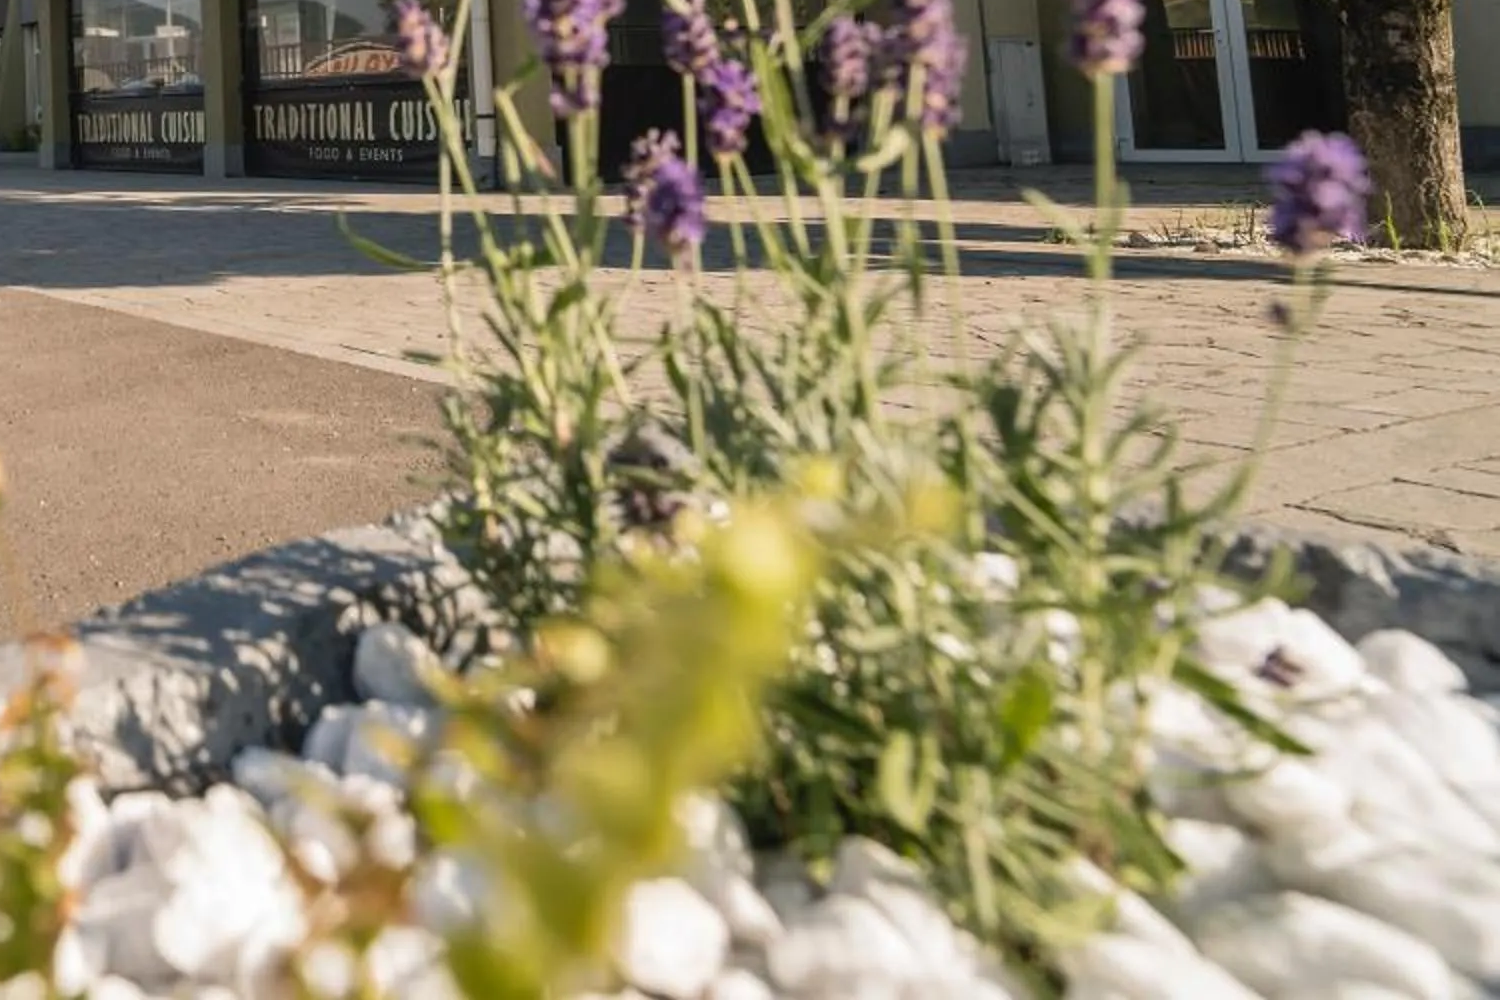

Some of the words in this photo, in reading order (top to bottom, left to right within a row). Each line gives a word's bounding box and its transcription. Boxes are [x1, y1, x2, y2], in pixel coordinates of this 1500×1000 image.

[77, 111, 154, 143] TRADITIONAL
[161, 110, 205, 143] CUISIN
[253, 101, 376, 141] TRADITIONAL
[359, 147, 403, 162] EVENTS
